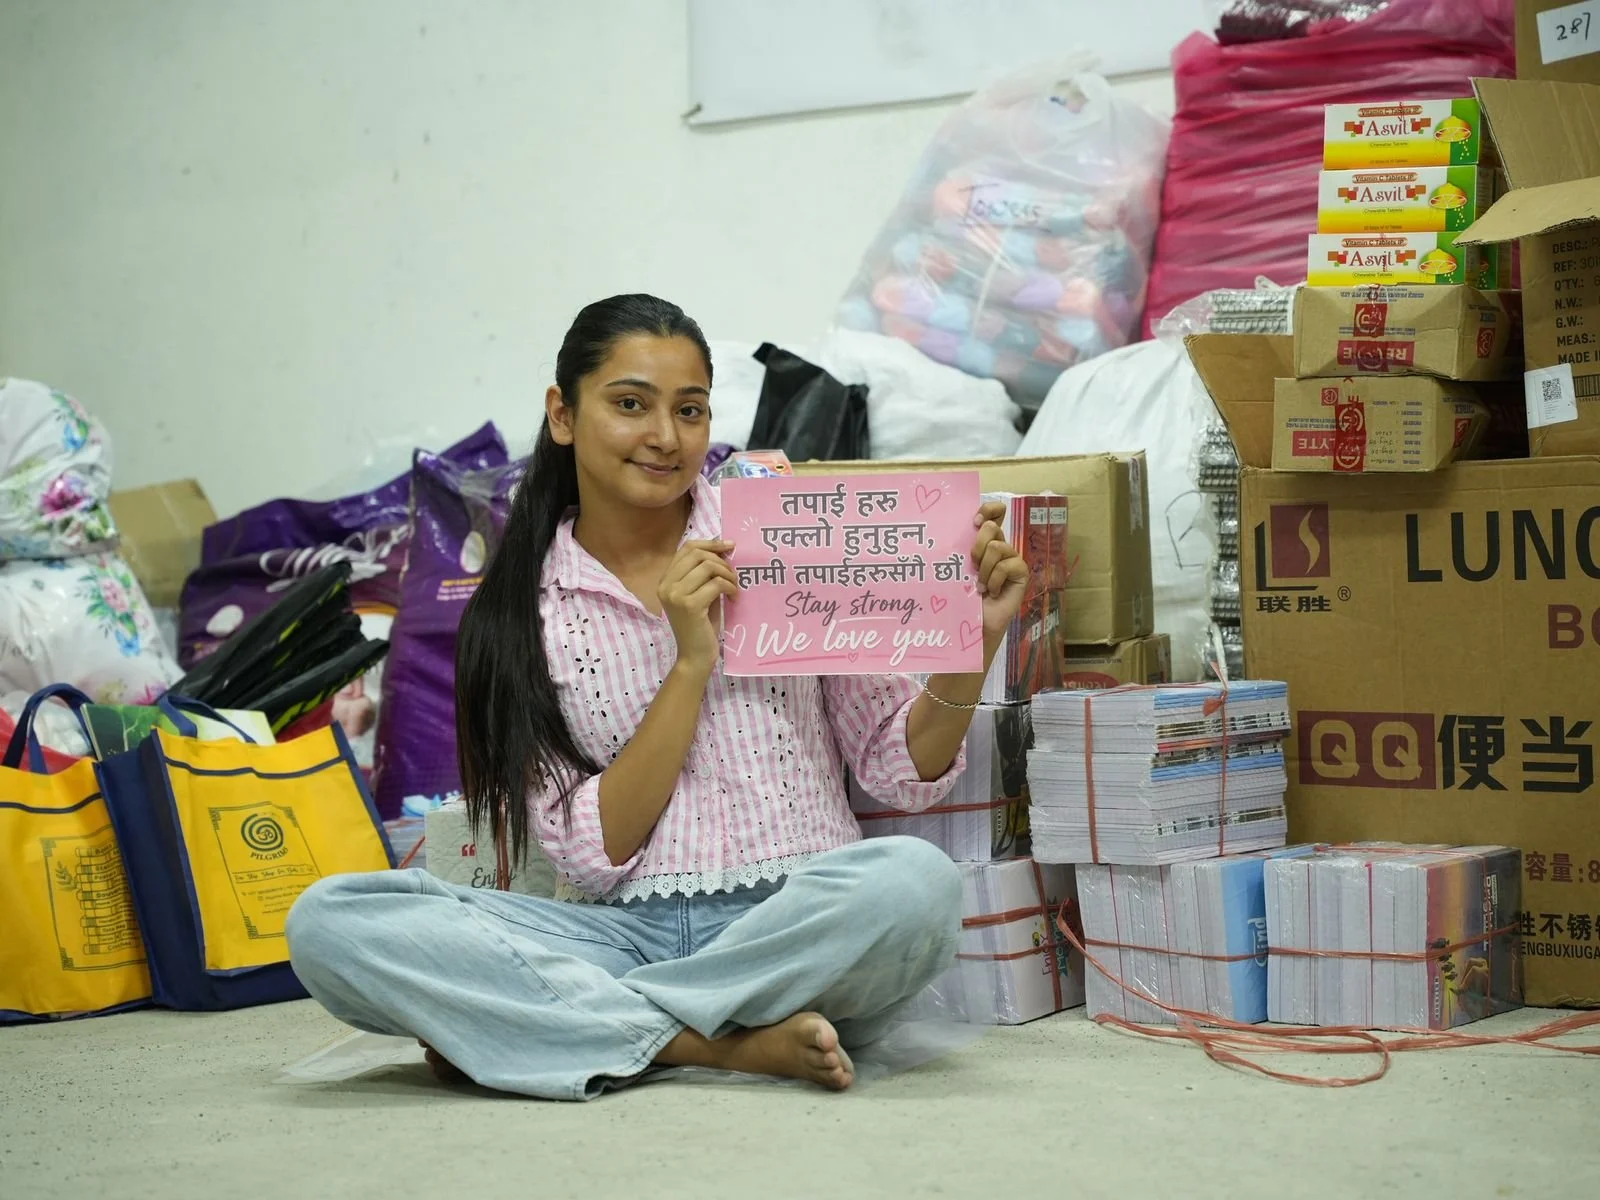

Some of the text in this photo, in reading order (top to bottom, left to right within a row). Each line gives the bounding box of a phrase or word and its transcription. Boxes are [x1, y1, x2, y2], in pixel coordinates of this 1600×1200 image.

[1556, 12, 1591, 41] 287
[1385, 174, 1407, 182] Tablets
[1553, 259, 1577, 273] REF:
[1554, 296, 1583, 311] N.W.:
[1555, 314, 1584, 329] G.W.:
[1556, 332, 1597, 348] MEAS.:
[1558, 351, 1591, 365] MADE
[760, 517, 834, 553] एक्लो
[735, 558, 787, 589] हामी
[785, 590, 923, 627] Stay strong.
[1255, 594, 1332, 613] 联胜
[1548, 603, 1600, 650] B
[756, 621, 814, 658] We
[823, 619, 884, 652] love
